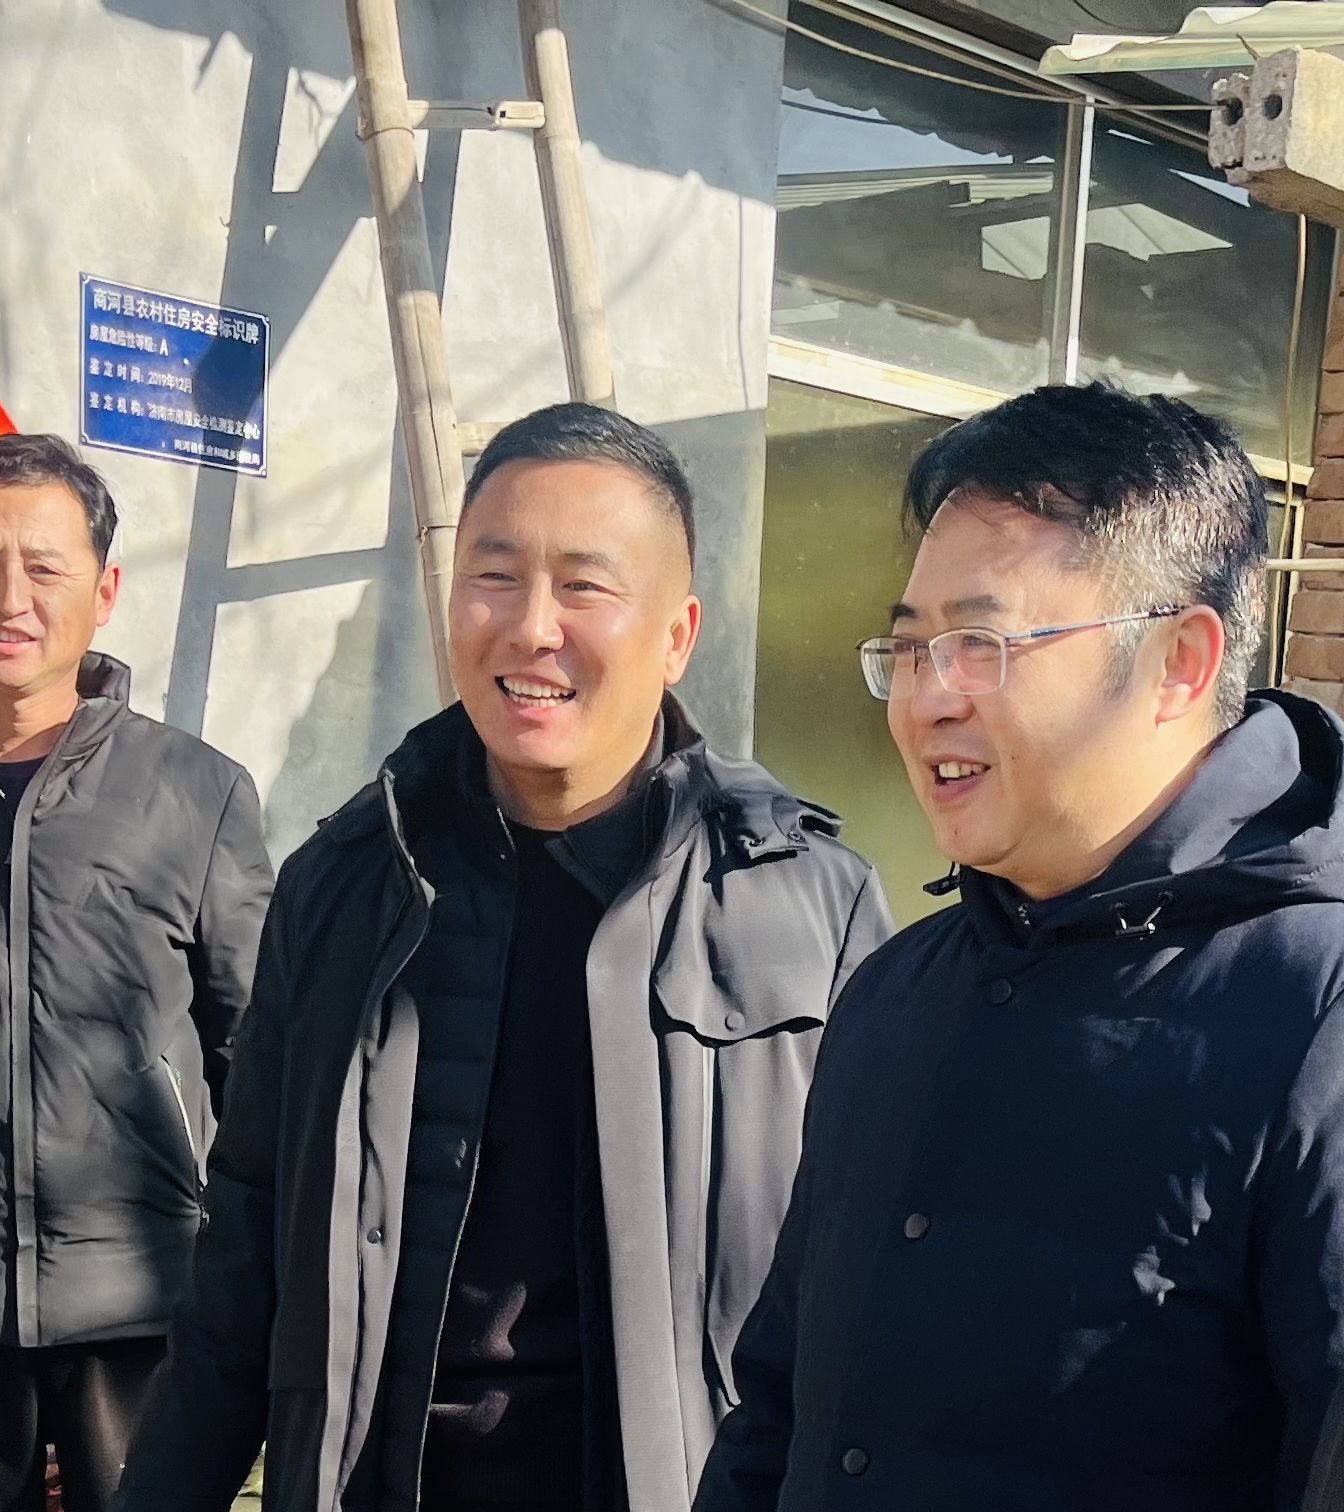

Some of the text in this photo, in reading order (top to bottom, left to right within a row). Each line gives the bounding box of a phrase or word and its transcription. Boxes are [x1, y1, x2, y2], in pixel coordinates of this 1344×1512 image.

[93, 288, 259, 345] 商河县农村住房安全标识牌
